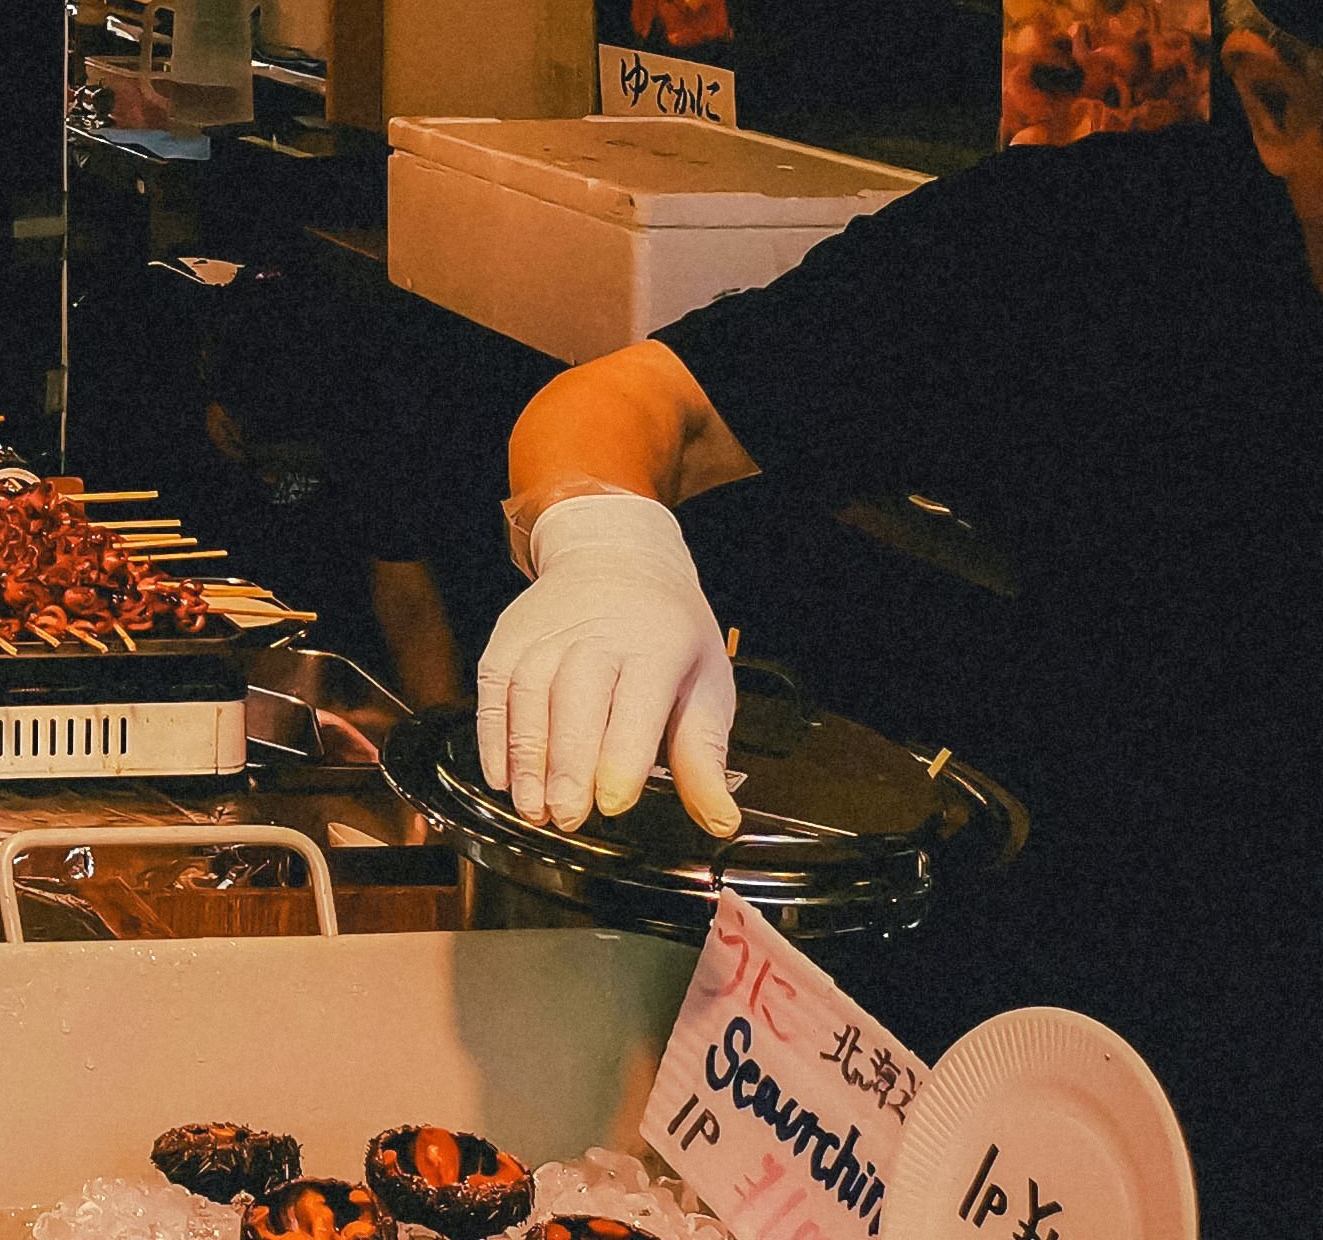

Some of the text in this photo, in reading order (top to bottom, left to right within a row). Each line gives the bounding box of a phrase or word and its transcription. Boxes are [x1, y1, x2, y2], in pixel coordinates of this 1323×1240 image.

[620, 52, 721, 123] ゆでかに
[717, 910, 798, 1043] うに
